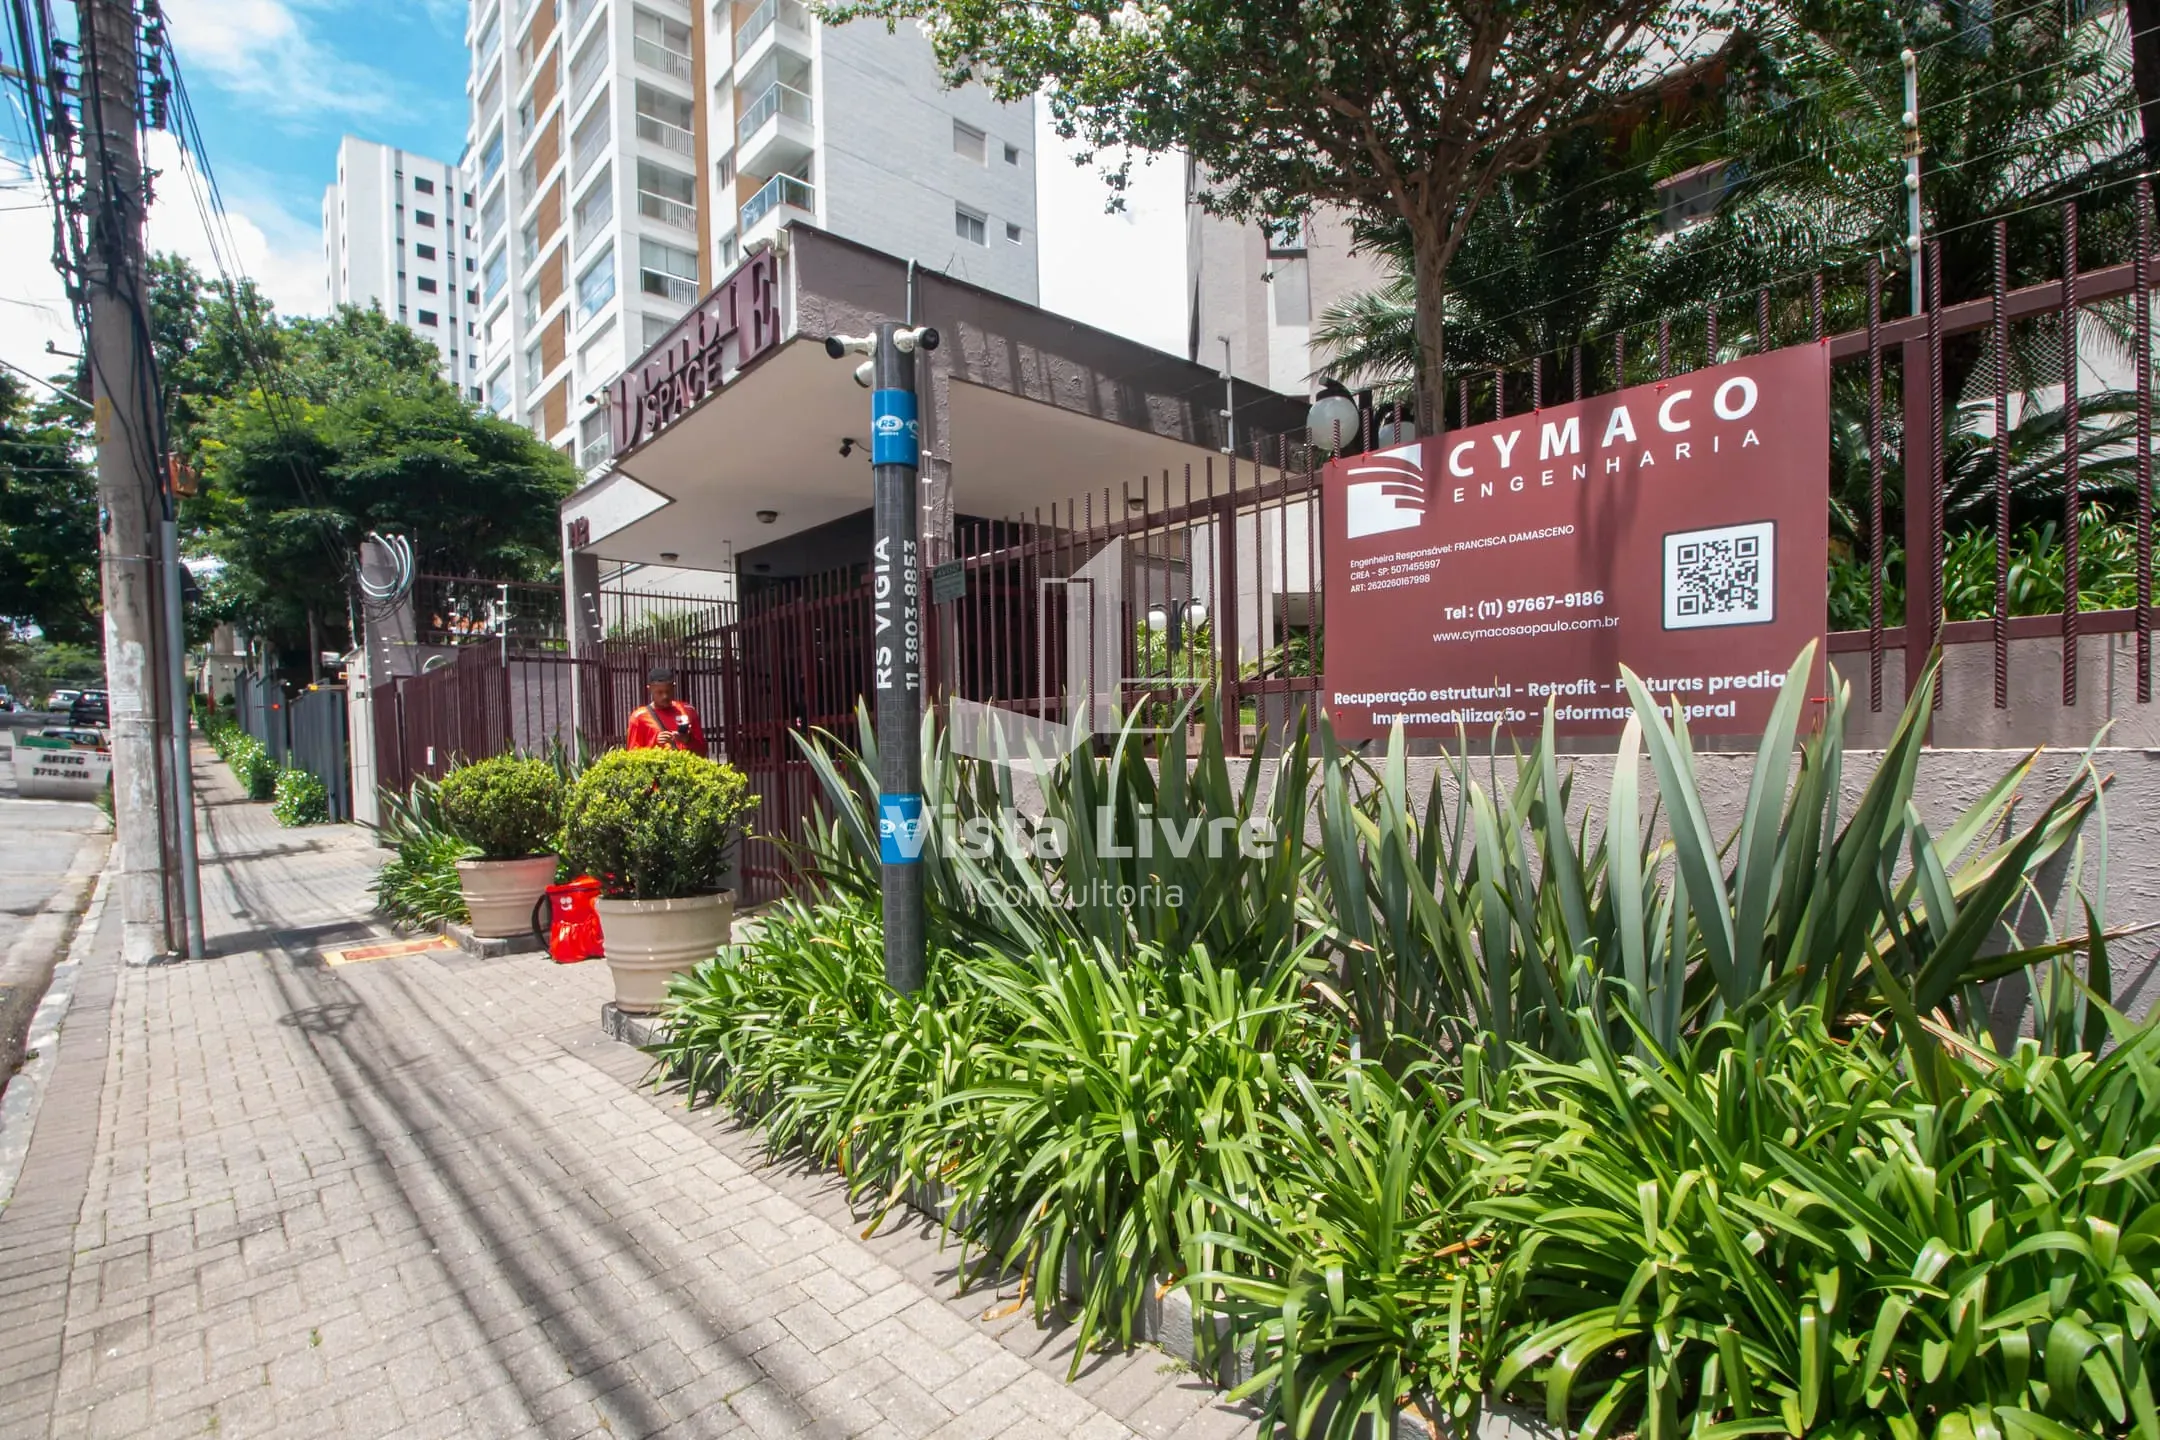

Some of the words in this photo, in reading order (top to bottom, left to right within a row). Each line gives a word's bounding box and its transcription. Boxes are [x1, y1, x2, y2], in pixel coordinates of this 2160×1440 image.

[644, 347, 722, 432] SPACE
[1448, 376, 1758, 477] CYMACO
[1453, 429, 1760, 503] ENGENHARIA
[1350, 553, 1395, 569] Engenheira
[1395, 544, 1453, 563] Responsável:
[1454, 534, 1507, 552] FRANCISCA
[1508, 524, 1575, 544] DAMASCENO
[874, 536, 891, 637] VIGIA
[1350, 570, 1371, 581] CREA
[1377, 566, 1390, 577] SP:
[1350, 583, 1366, 594] ART:
[903, 539, 919, 665] 3803-8853
[1444, 606, 1467, 621] Tel
[1477, 598, 1503, 620] (11)
[1507, 590, 1605, 614] 97667-9186
[1433, 616, 1620, 643] www.cymacosaopaulo.com.br
[875, 646, 893, 690] RS
[905, 672, 919, 692] 11
[1334, 687, 1428, 708] Recuperação
[1429, 683, 1511, 701] estrutural
[1527, 679, 1597, 697] Retrofit
[1615, 675, 1704, 694] Pturas
[1708, 667, 1794, 695] predia
[1372, 705, 1526, 726] Impermeabilização
[1682, 700, 1736, 723] geral
